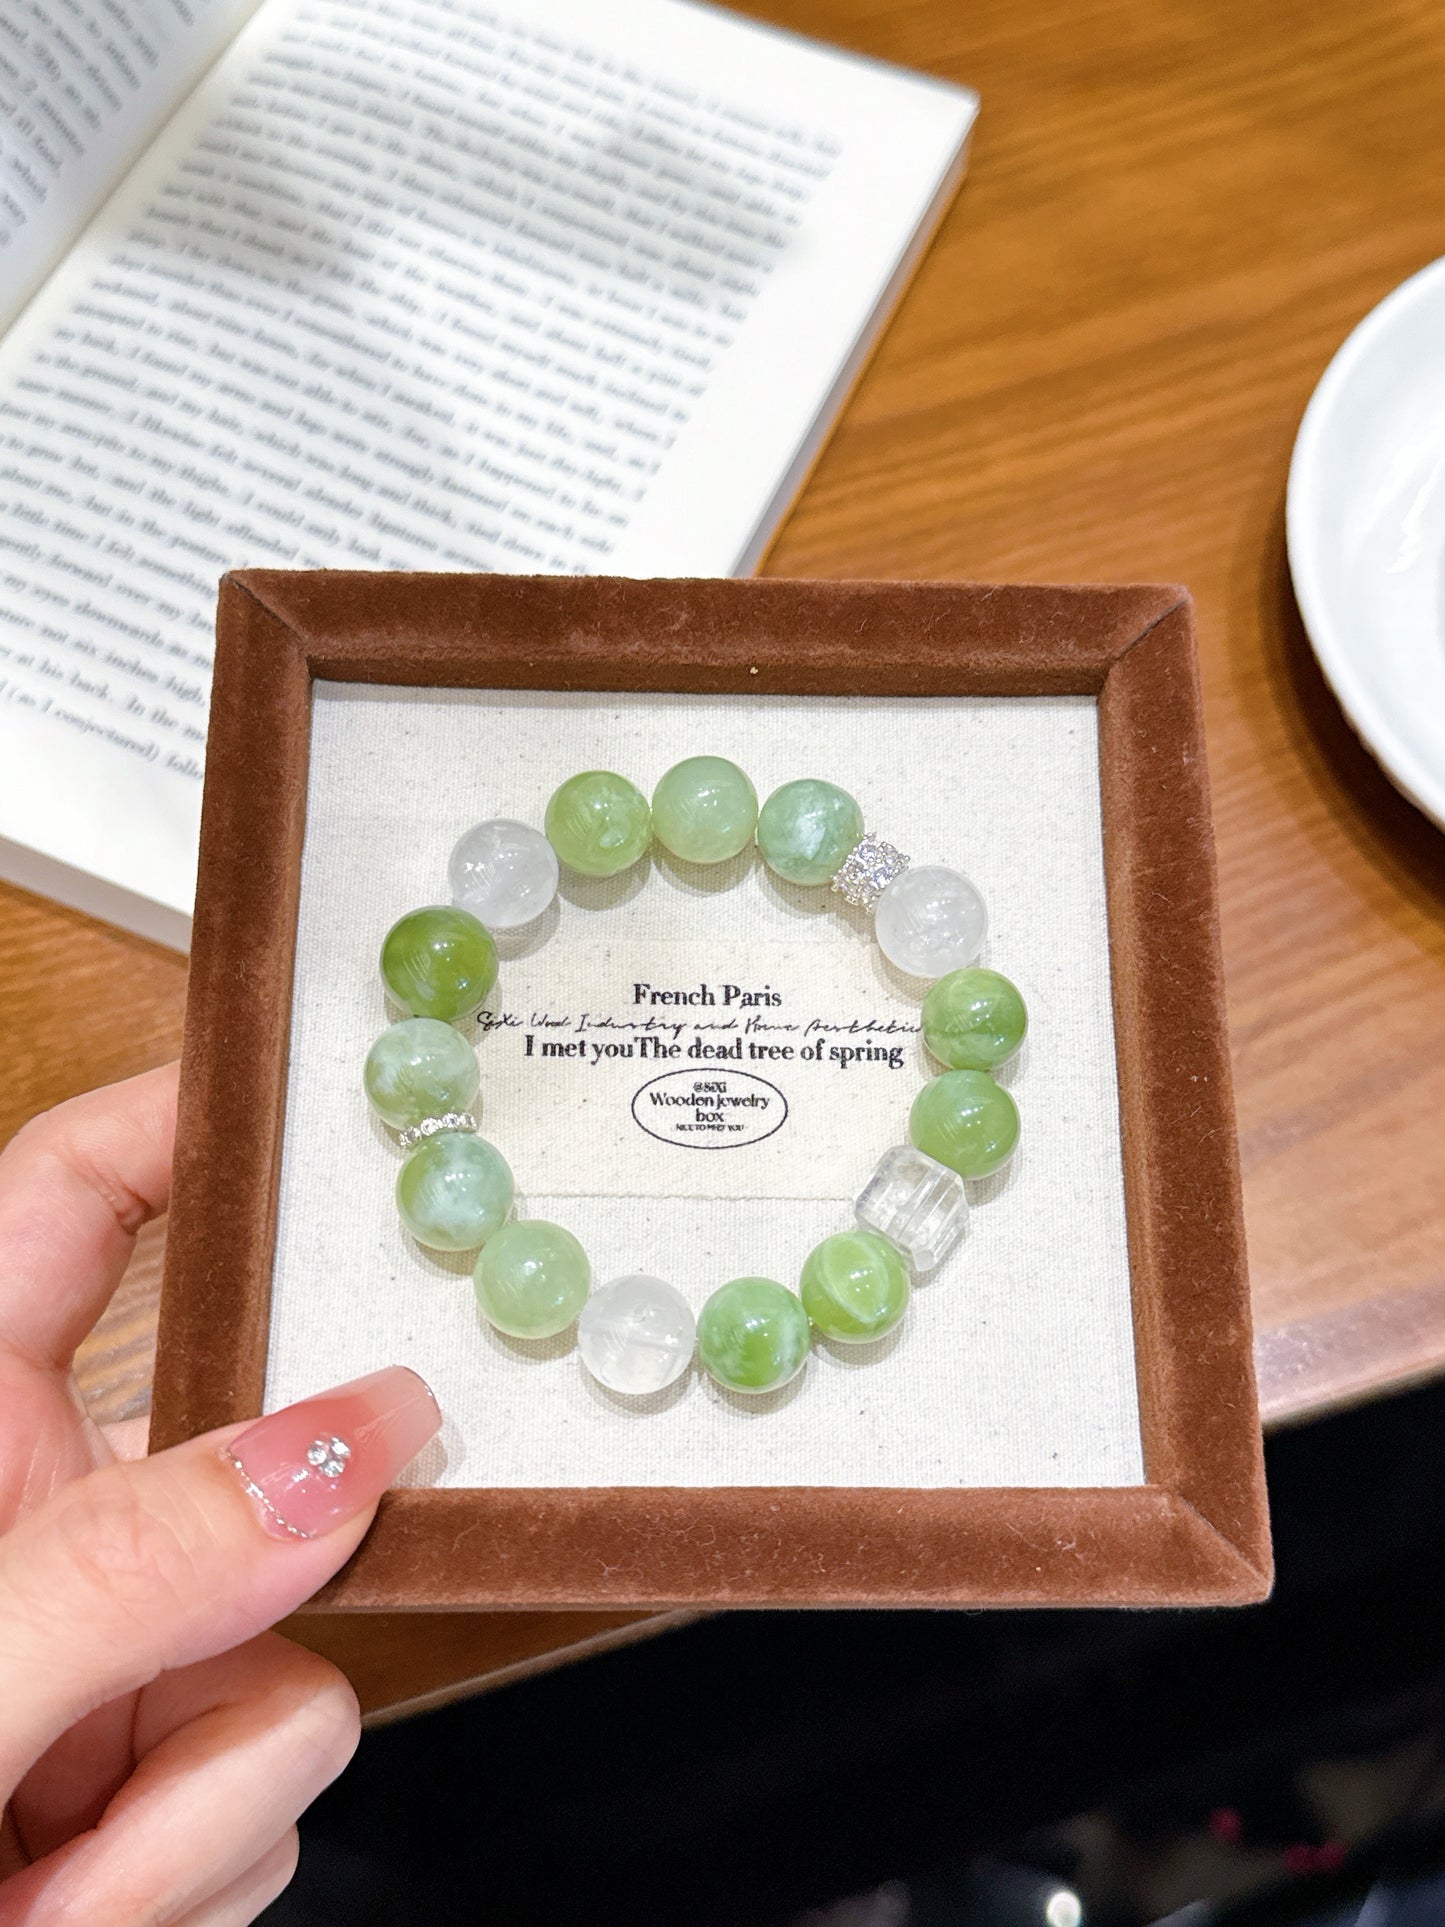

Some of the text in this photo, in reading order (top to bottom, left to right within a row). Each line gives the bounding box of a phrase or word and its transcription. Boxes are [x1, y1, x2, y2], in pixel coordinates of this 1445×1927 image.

[633, 983, 782, 1009] French Paris
[693, 1018, 739, 1031] and
[524, 1034, 535, 1057] I
[542, 1039, 586, 1058] met
[688, 1036, 742, 1060] dead
[748, 1042, 794, 1060] tree
[800, 1037, 825, 1061] of
[829, 1039, 904, 1070] spring
[695, 1108, 724, 1122] box
